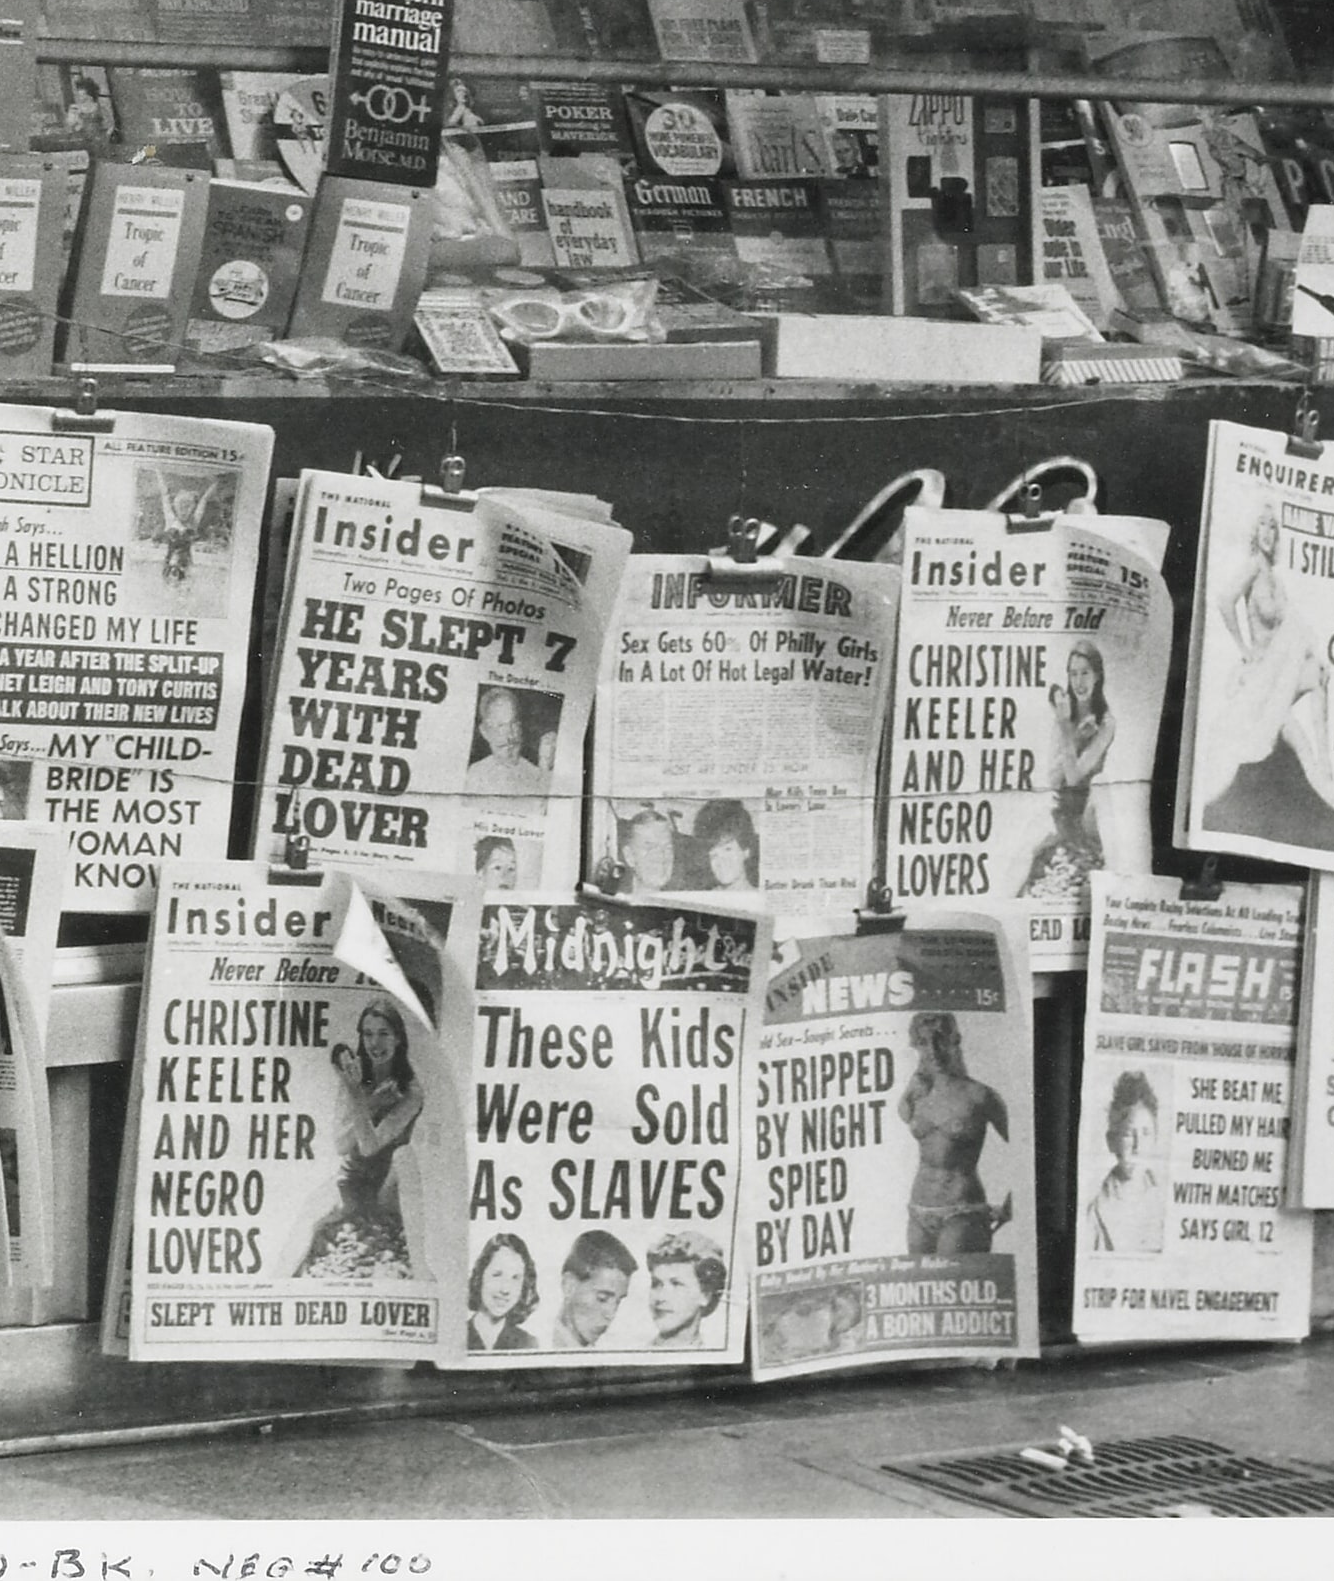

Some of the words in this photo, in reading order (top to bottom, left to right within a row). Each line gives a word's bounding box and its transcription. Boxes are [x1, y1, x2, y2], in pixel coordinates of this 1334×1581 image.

[354, 20, 441, 54] manual
[342, 120, 430, 151] Benjamin
[634, 182, 712, 206] German
[731, 188, 808, 209] FRENCH
[21, 446, 85, 466] STAR
[5, 540, 19, 566] A
[29, 542, 123, 572] HELLION
[314, 506, 475, 563] Insider
[1288, 539, 1294, 570] I
[343, 572, 377, 596] Two
[385, 579, 441, 606] Pages
[451, 586, 476, 606] Of
[481, 591, 546, 620] Photos
[107, 617, 141, 642] MY
[151, 618, 199, 646] LIFE
[300, 597, 365, 644] HE
[381, 608, 526, 665] SLEPT
[544, 632, 578, 672] 7
[620, 631, 650, 656] Sex
[658, 630, 693, 654] Gets
[750, 631, 768, 651] Of
[776, 631, 826, 658] Philly
[837, 636, 879, 664] Girls
[296, 647, 450, 704] YEARS
[619, 659, 635, 683] In
[640, 662, 653, 682] A
[660, 660, 686, 683] Lot
[693, 659, 712, 681] Of
[718, 660, 747, 682] Hot
[754, 660, 794, 686] Legal
[802, 659, 872, 688] Water!
[289, 696, 422, 750] WITH
[278, 744, 411, 797] DEAD
[271, 794, 430, 849] LOVER
[490, 905, 730, 990] Midnight
[1136, 948, 1275, 999] FLASH
[803, 971, 914, 1015] NEWS
[477, 1006, 614, 1069] These
[641, 1007, 735, 1069] Kids
[757, 1047, 895, 1108] STRIPPED
[475, 1083, 594, 1145] Were
[631, 1083, 729, 1145] Sold
[756, 1111, 790, 1160] BY
[801, 1099, 886, 1155] NIGHT
[470, 1159, 523, 1220] As
[548, 1159, 726, 1220] SLAVES
[768, 1157, 848, 1212] SPIED
[756, 1217, 793, 1267] BY
[803, 1208, 855, 1257] DAY
[1084, 1288, 1117, 1309] STRIP
[1121, 1288, 1146, 1309] FOR
[1150, 1289, 1191, 1311] NAVEL
[1195, 1291, 1279, 1313] ENGAGEMENT
